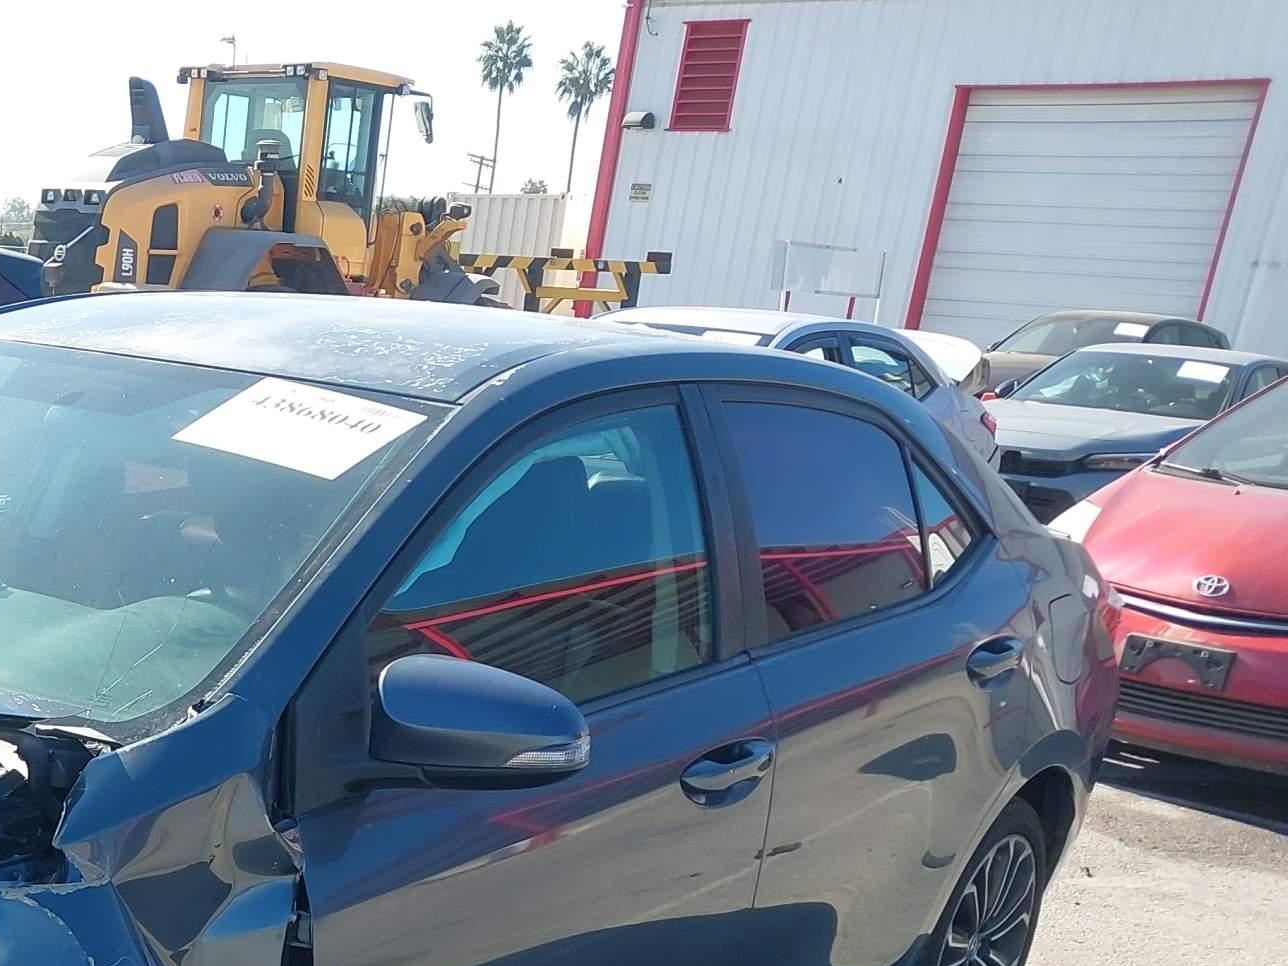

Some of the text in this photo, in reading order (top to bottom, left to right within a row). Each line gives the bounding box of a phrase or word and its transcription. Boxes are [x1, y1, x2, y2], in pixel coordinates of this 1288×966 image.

[207, 172, 247, 181] VOLVO
[120, 248, 134, 277] L90H
[251, 396, 381, 434] 43868040
